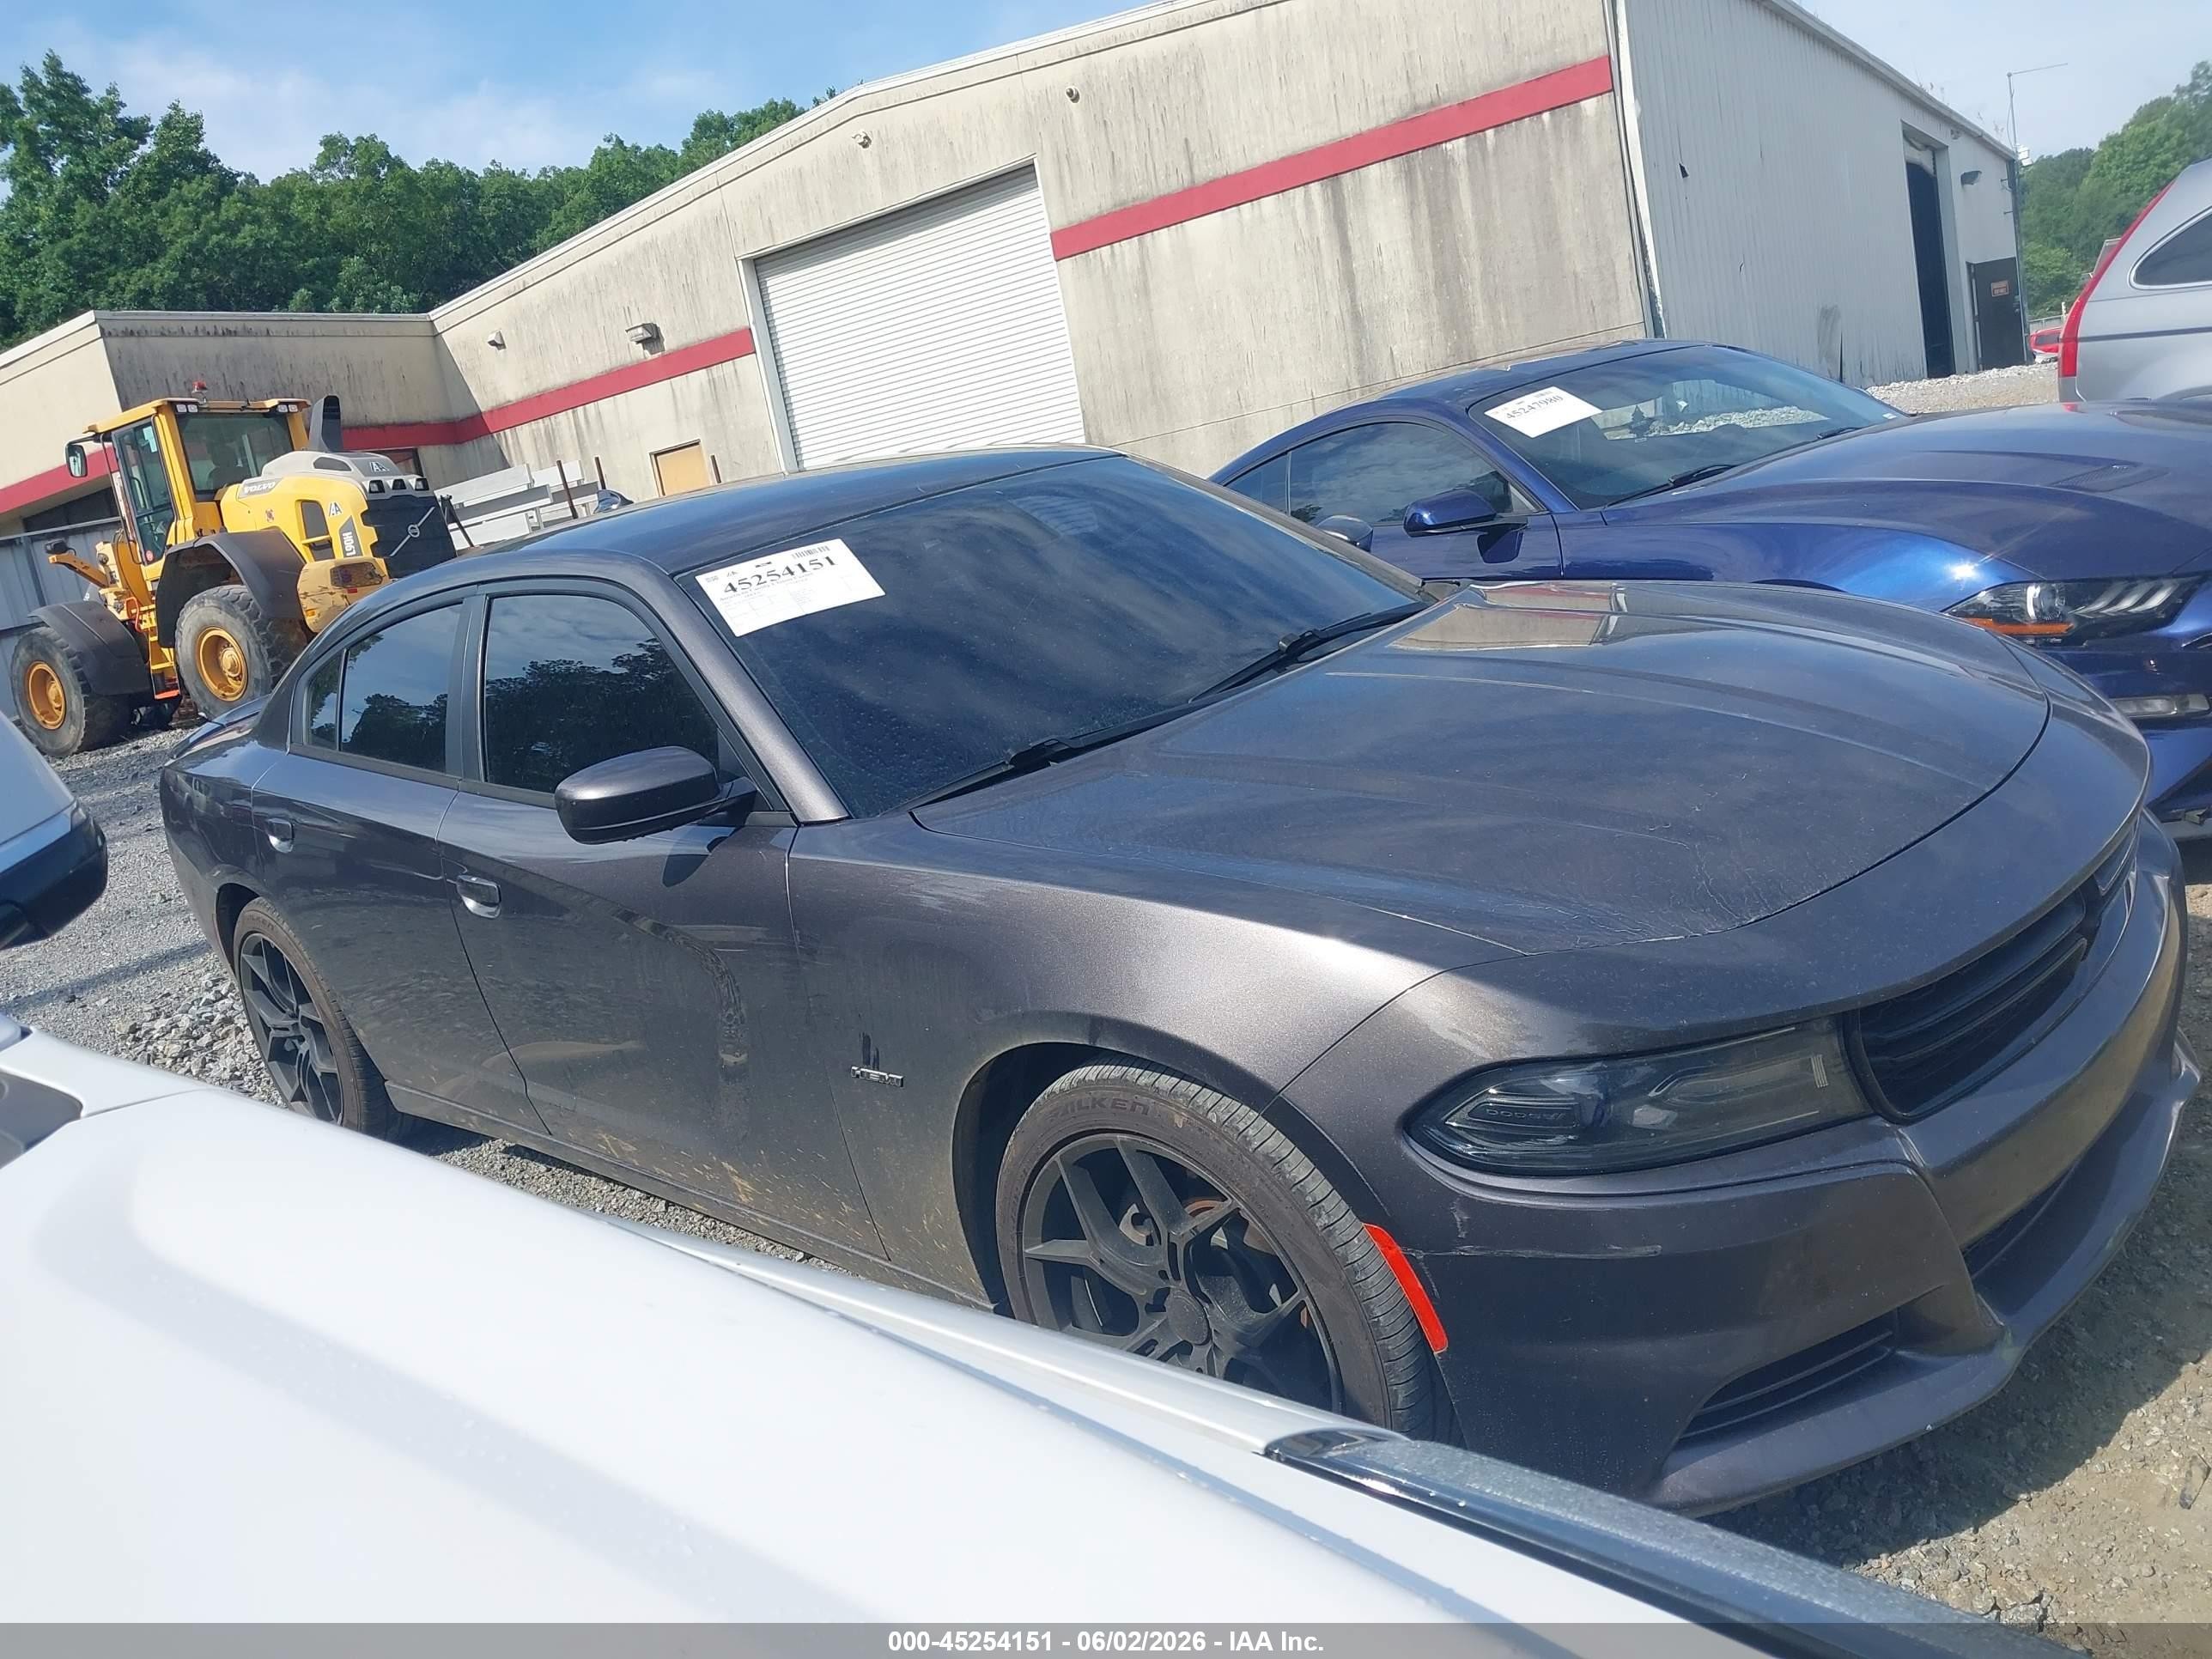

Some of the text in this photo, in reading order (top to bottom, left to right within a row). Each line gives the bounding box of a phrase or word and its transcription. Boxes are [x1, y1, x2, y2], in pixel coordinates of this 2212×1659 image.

[243, 481, 276, 494] VOLVO
[342, 531, 356, 556] L90H
[723, 555, 838, 594] 45254151
